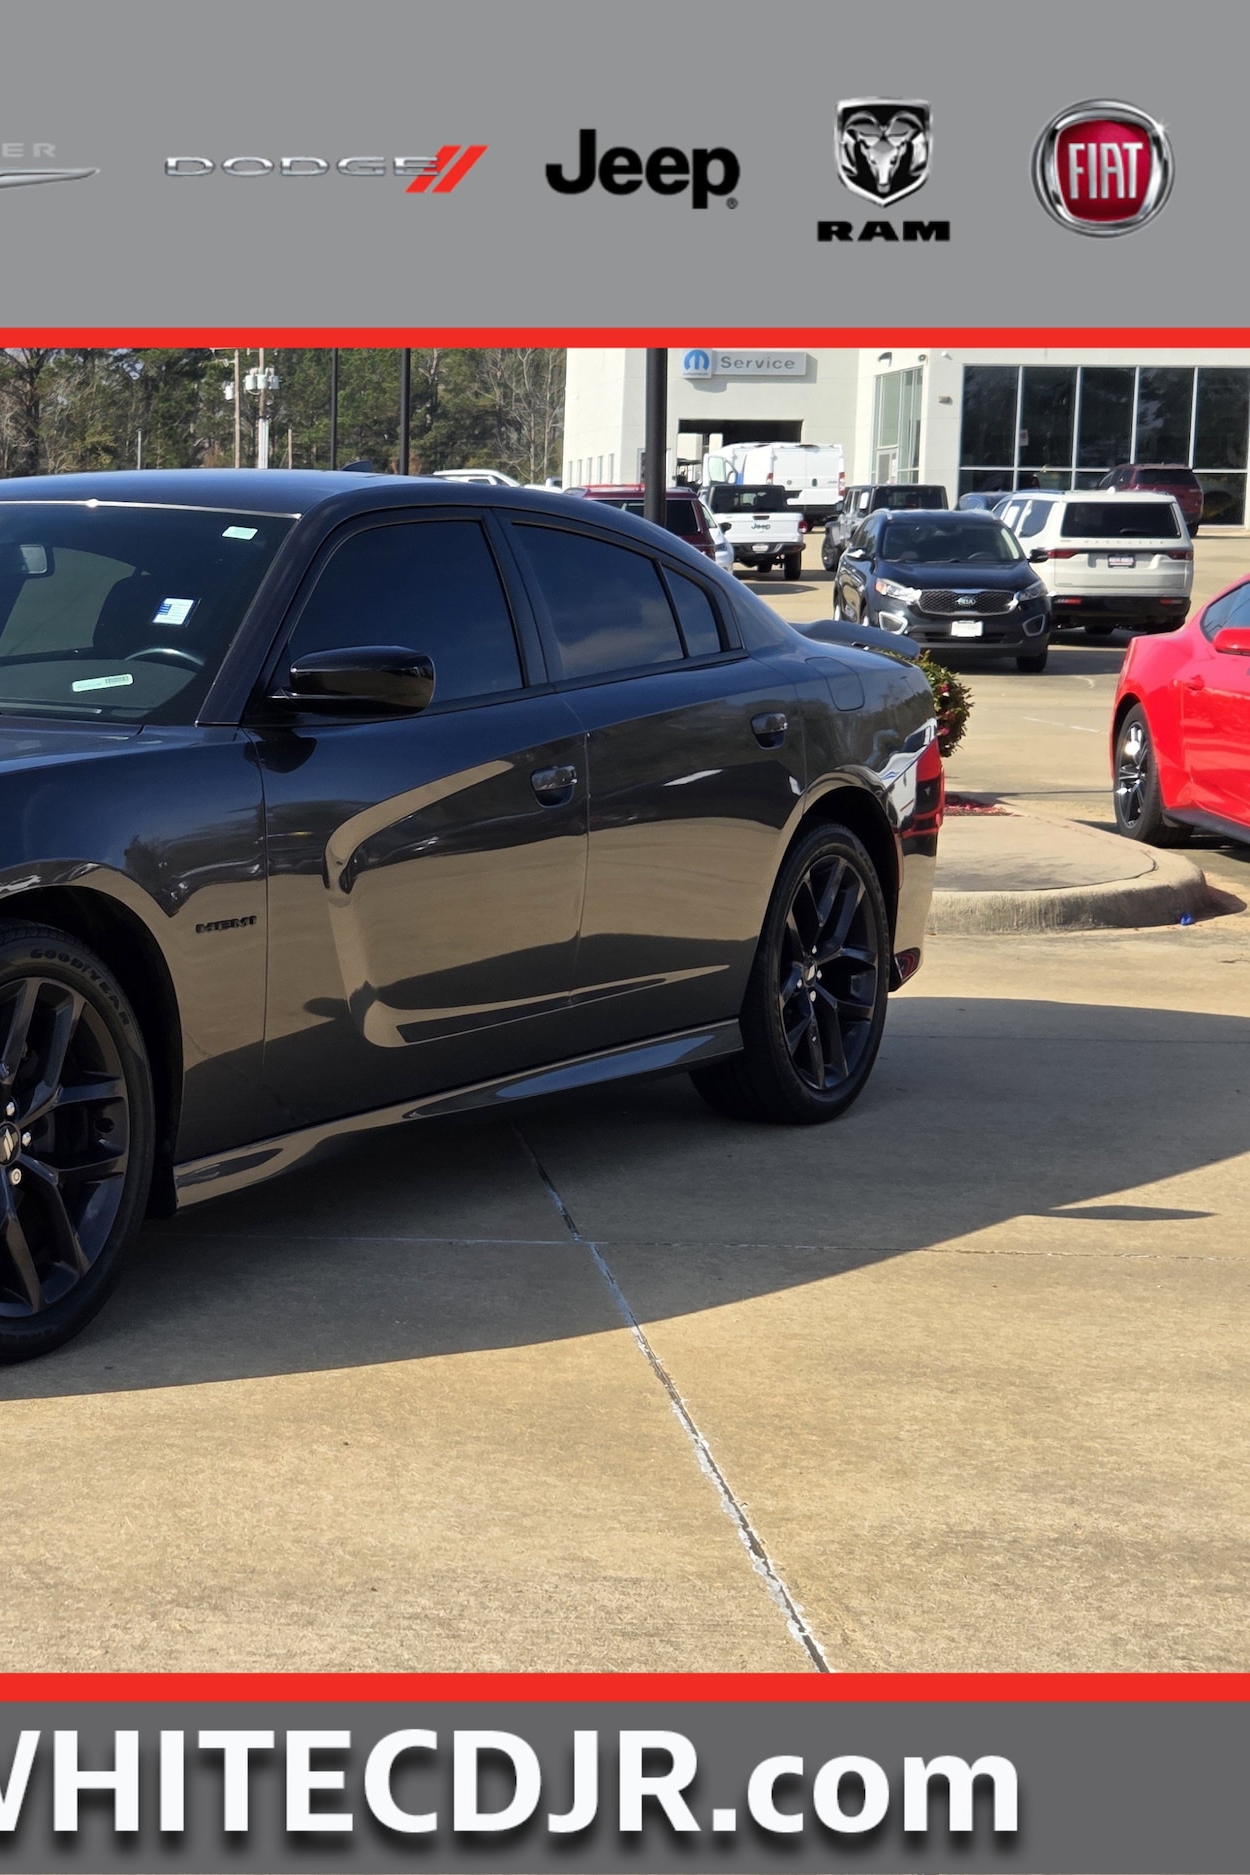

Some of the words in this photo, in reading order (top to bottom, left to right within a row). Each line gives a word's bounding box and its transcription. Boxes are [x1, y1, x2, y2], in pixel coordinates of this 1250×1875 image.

[720, 356, 795, 370] Service
[750, 522, 771, 530] Jeep
[195, 915, 257, 933] HEMI
[30, 948, 130, 1025] GOODYEAR
